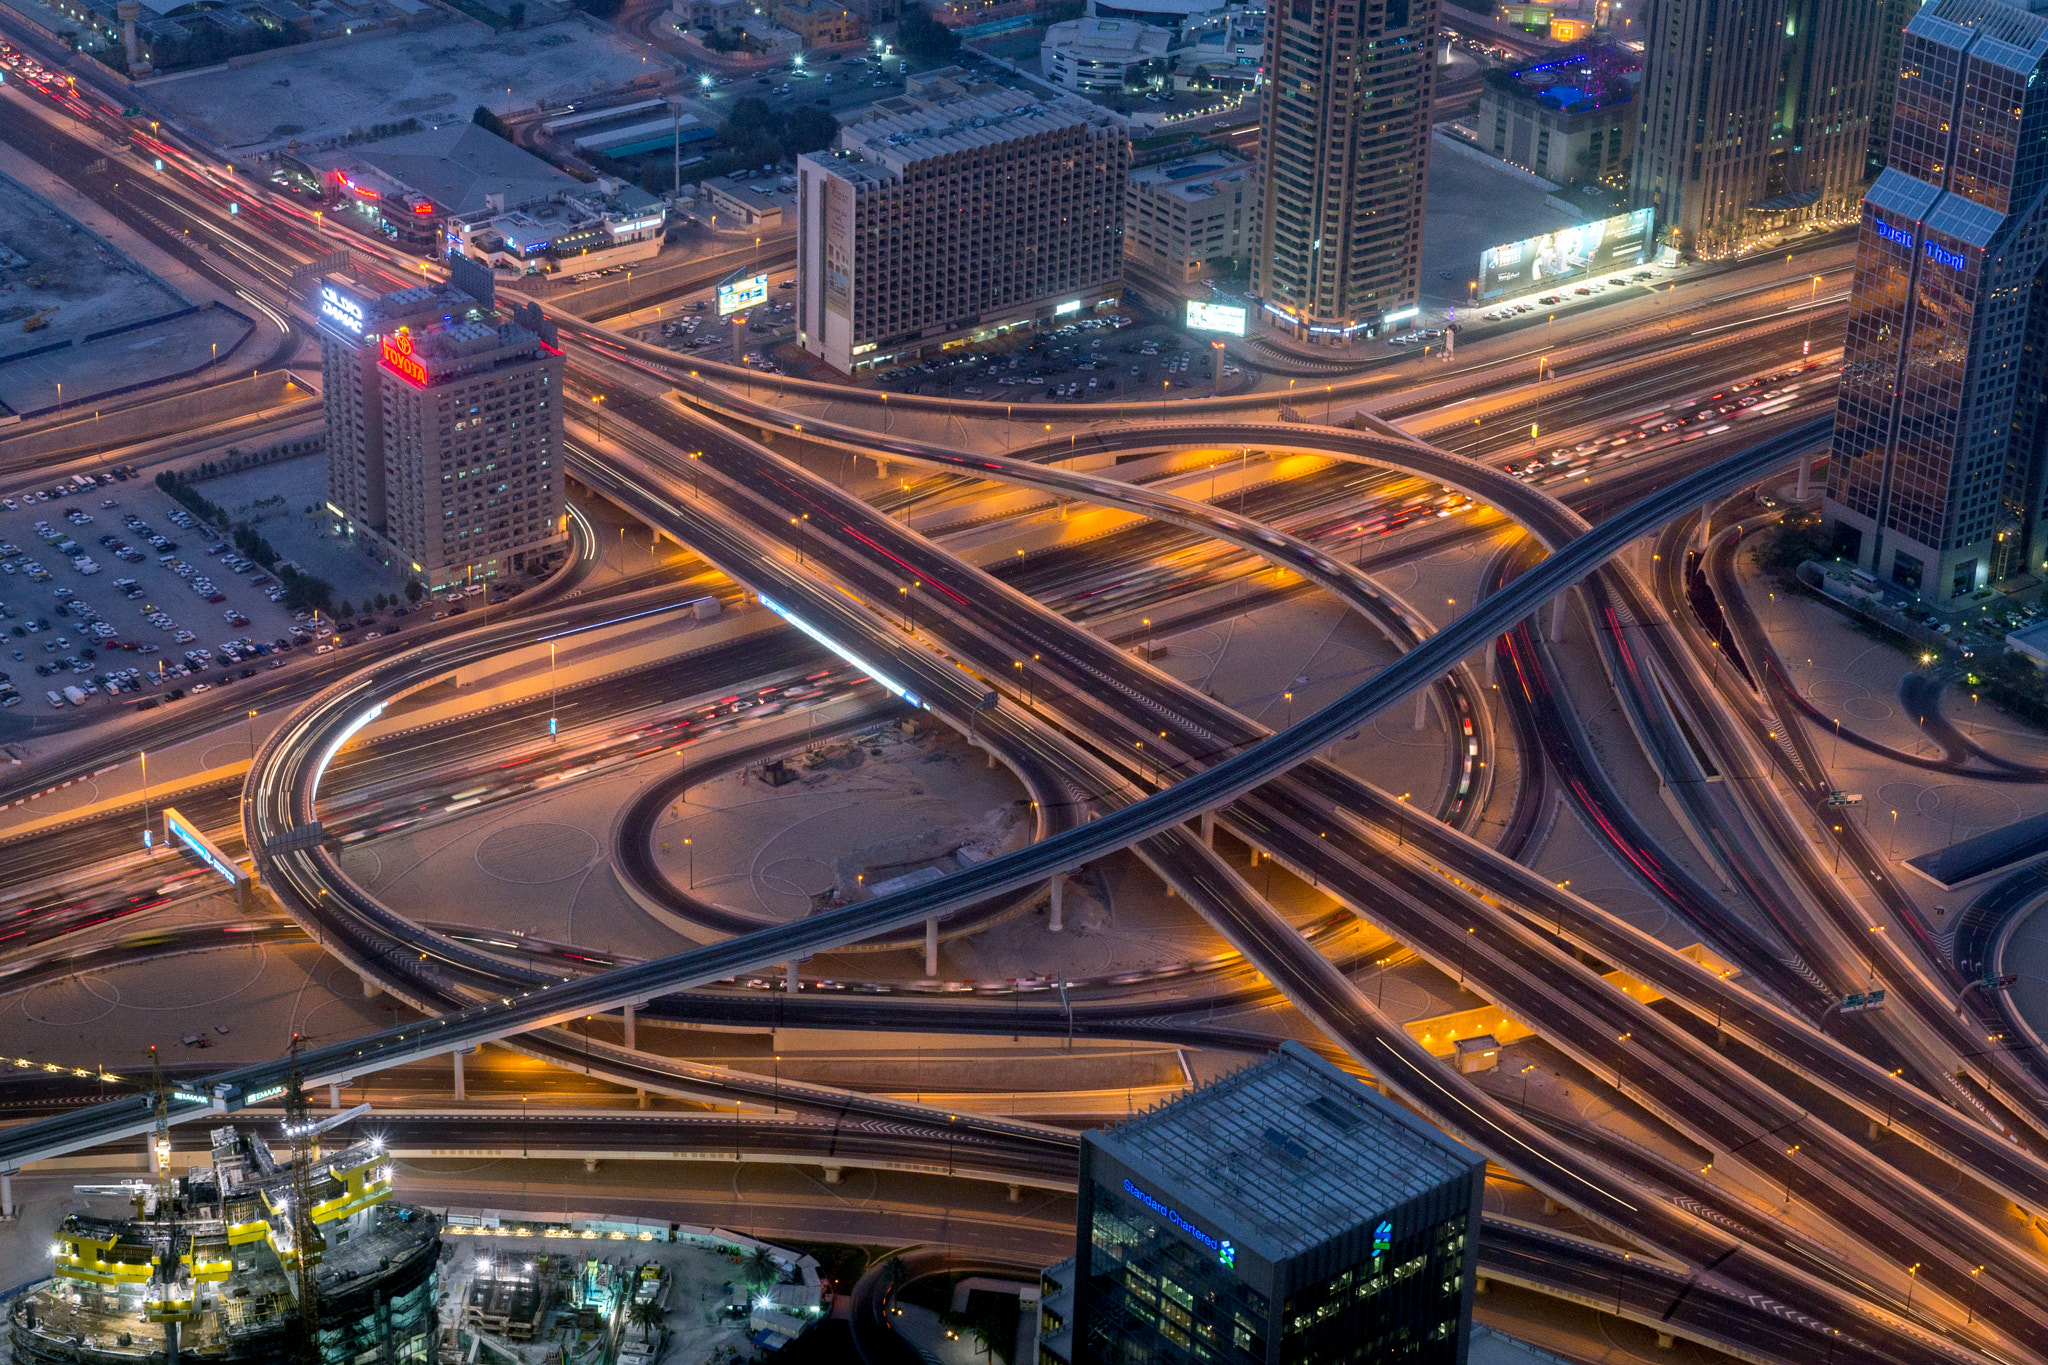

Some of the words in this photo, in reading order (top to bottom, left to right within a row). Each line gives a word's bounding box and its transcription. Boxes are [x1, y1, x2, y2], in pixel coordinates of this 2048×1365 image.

[1875, 218, 1913, 249] Dusit
[1924, 239, 1965, 272] Thani
[322, 300, 363, 334] DAMAC
[382, 343, 427, 385] TOYOTA
[256, 1086, 282, 1100] EMAAR
[1123, 1178, 1168, 1217] Standard
[1168, 1209, 1218, 1251] Chartered
